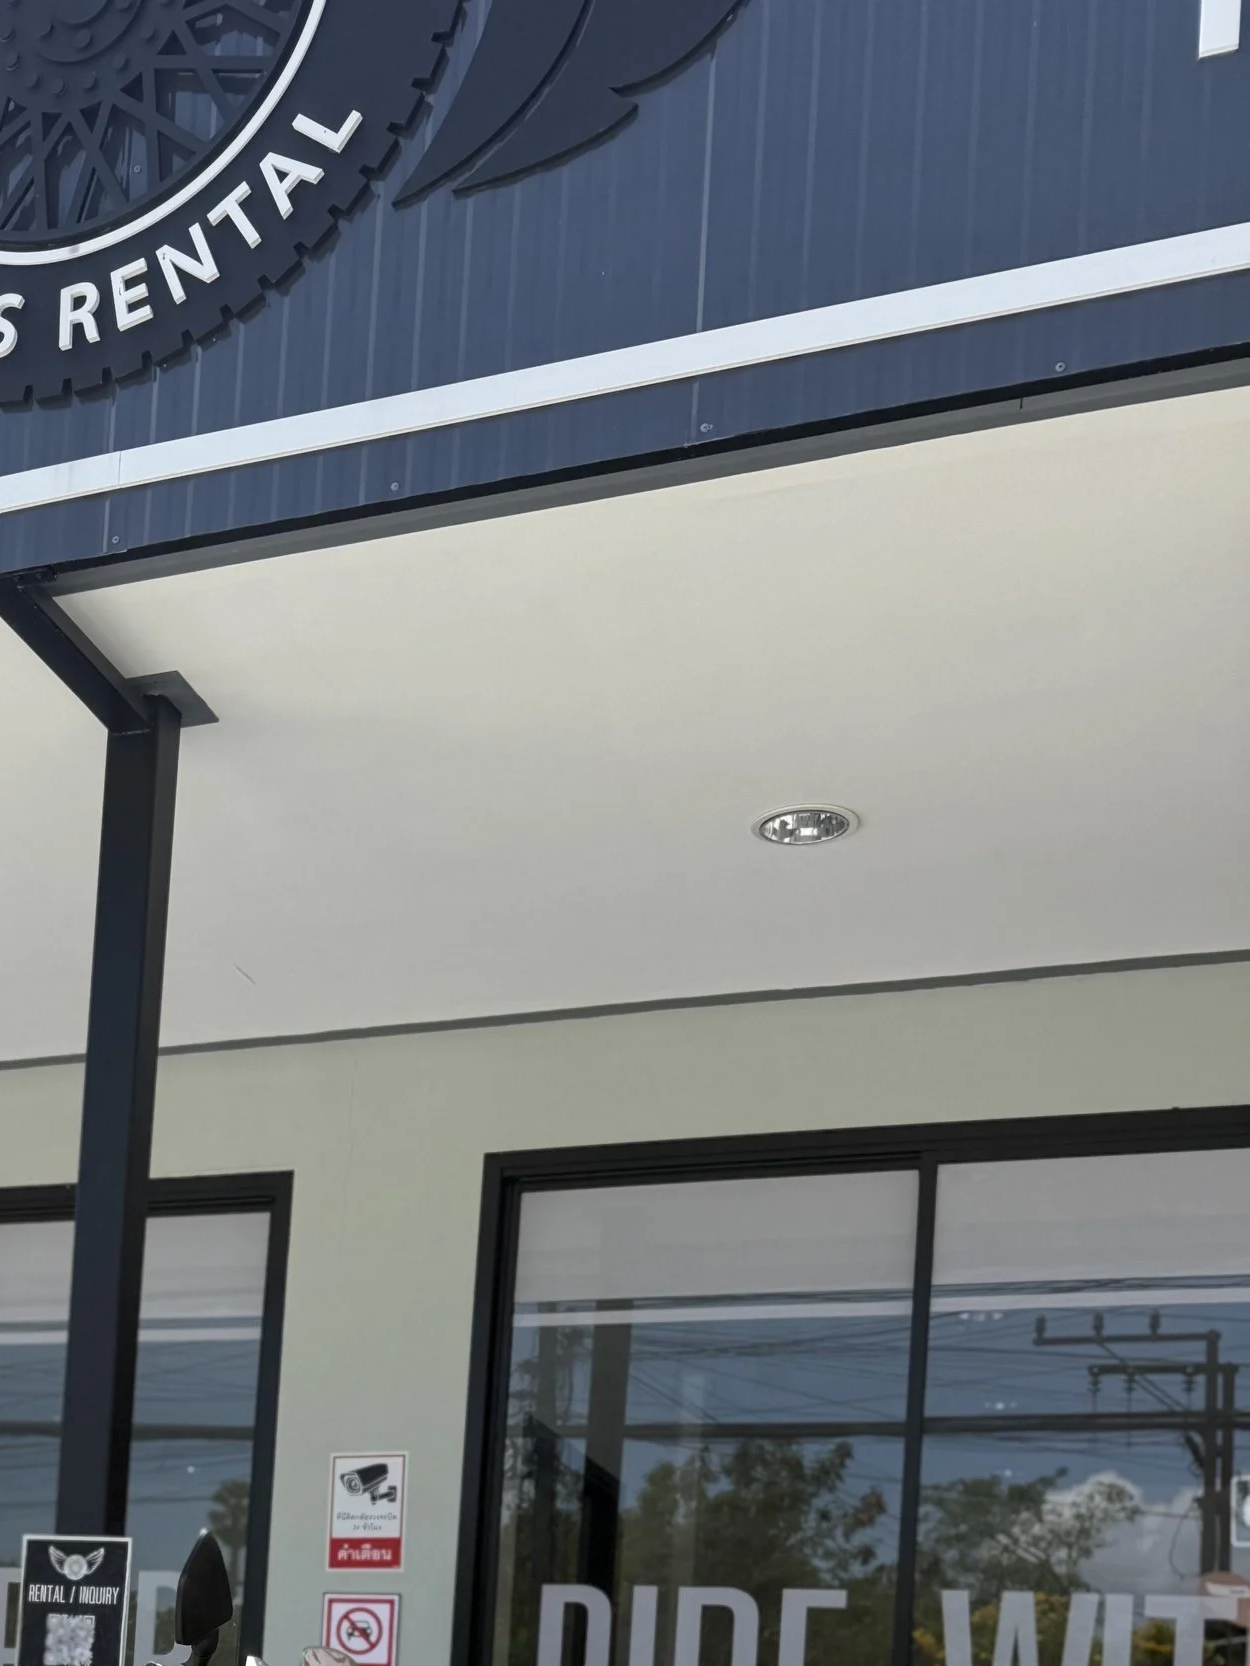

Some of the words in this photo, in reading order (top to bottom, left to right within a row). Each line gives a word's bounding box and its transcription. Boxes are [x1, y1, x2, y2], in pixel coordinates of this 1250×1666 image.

[58, 109, 363, 352] RENTAL
[337, 1543, 393, 1561] คำเตือน
[28, 1584, 66, 1604] RENTAL
[79, 1585, 120, 1605] INQUIRY
